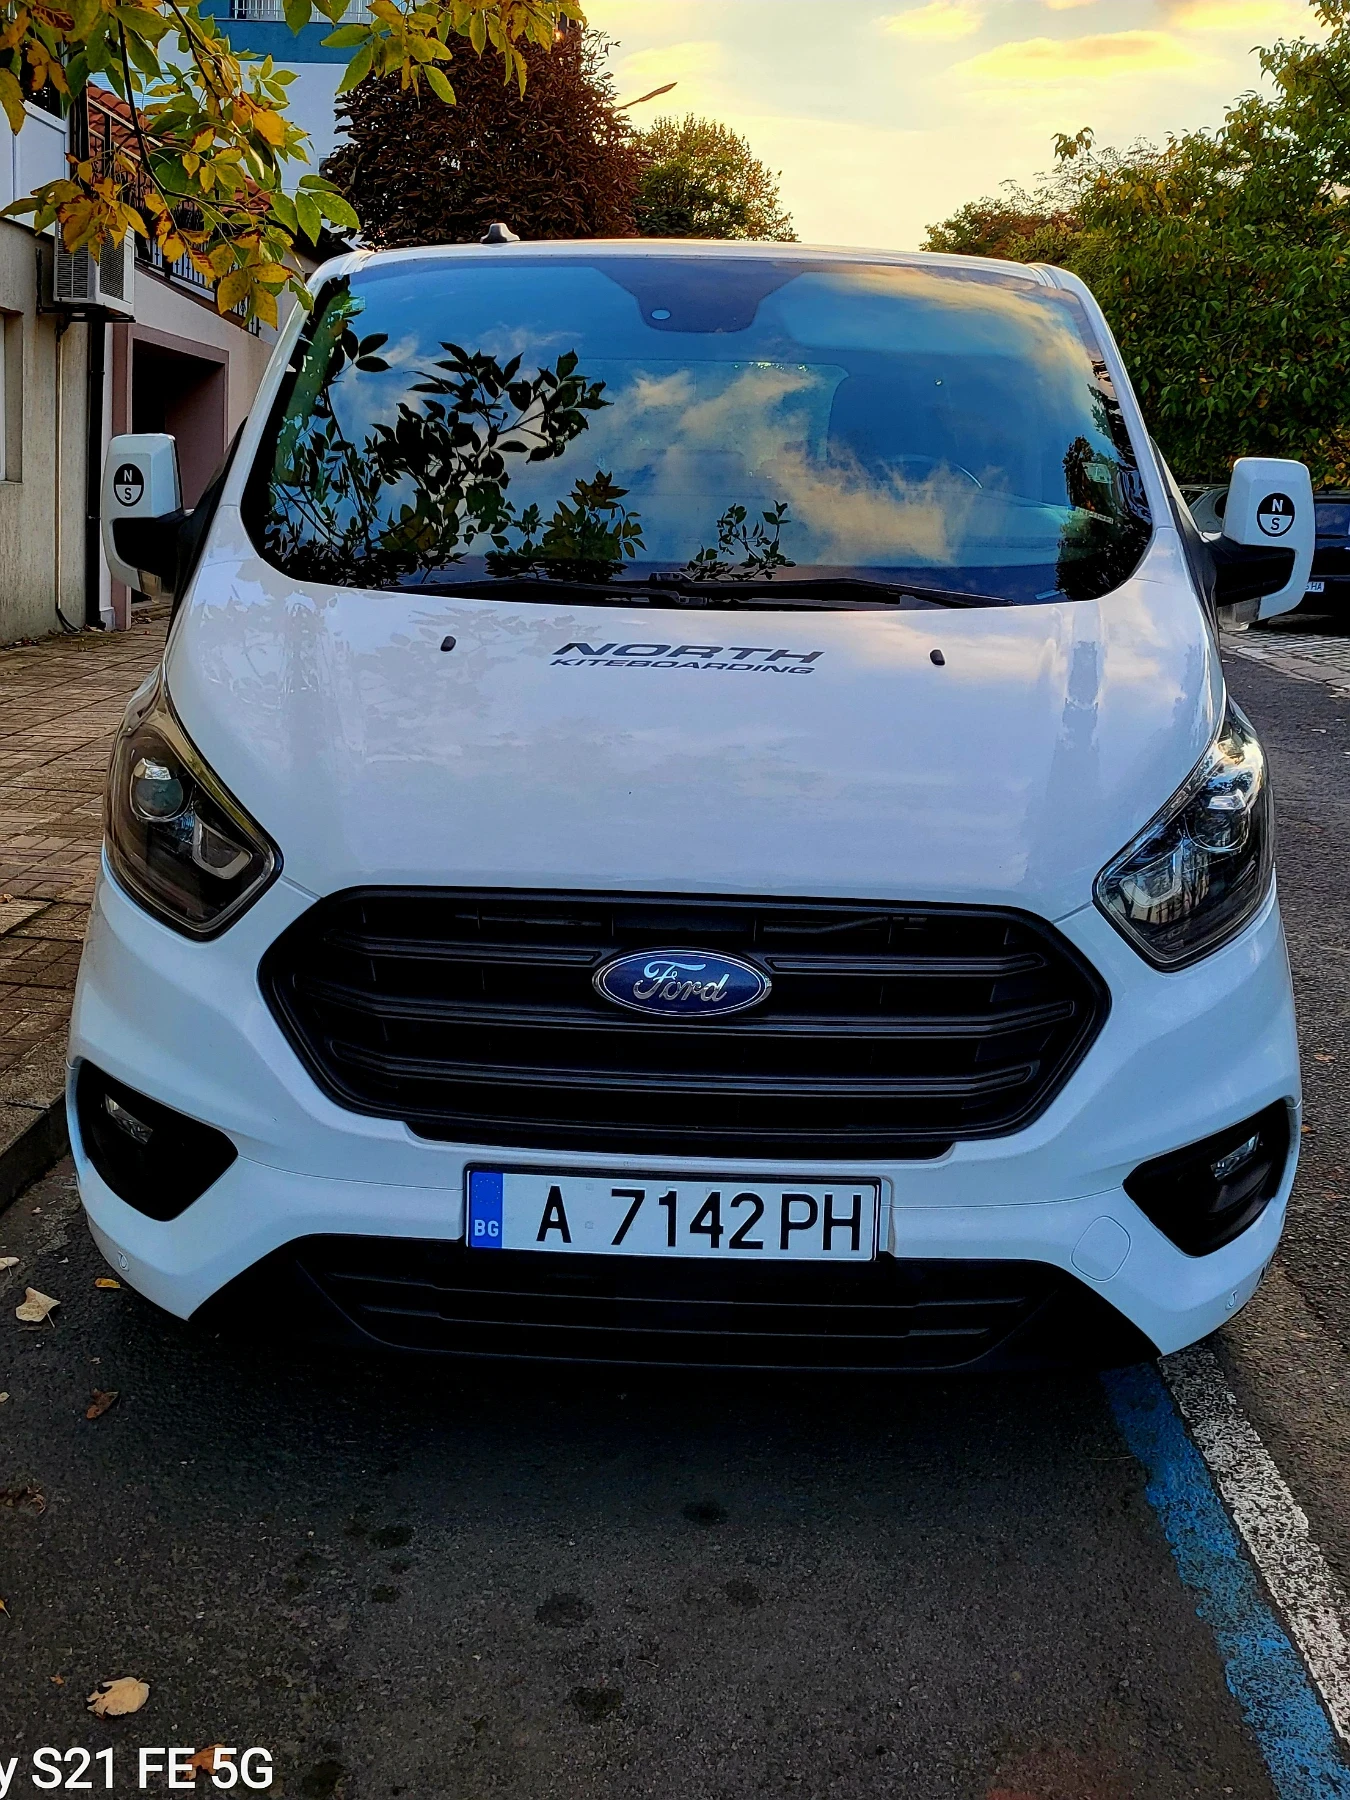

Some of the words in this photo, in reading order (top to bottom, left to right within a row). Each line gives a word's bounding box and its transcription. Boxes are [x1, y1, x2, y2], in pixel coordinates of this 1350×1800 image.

[123, 469, 133, 482] N
[124, 487, 132, 501] S
[1271, 498, 1284, 512] N
[1270, 517, 1281, 531] S
[553, 642, 825, 663] NORTH
[549, 658, 815, 675] KITEBOARDING
[633, 960, 730, 1002] Ford
[535, 1184, 572, 1244] A
[610, 1186, 765, 1251] 7142
[779, 1191, 863, 1252] PH
[474, 1219, 499, 1238] BG
